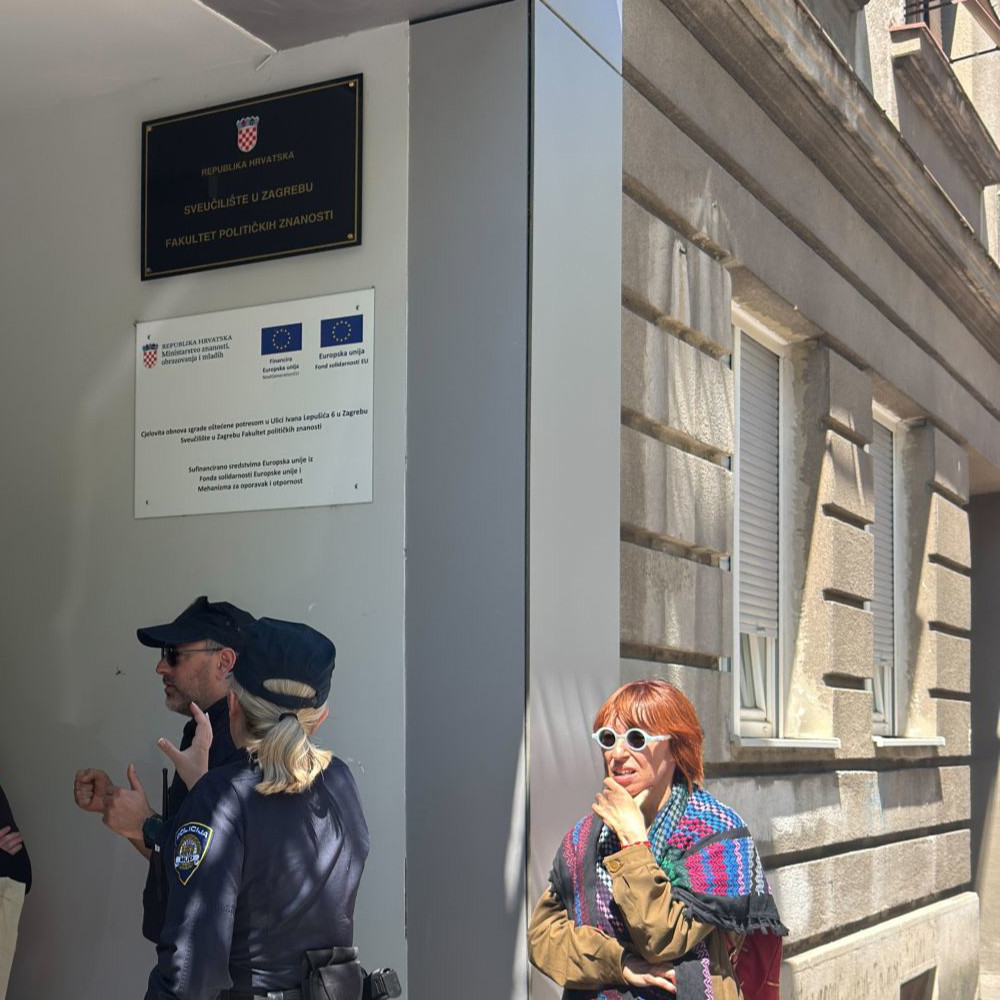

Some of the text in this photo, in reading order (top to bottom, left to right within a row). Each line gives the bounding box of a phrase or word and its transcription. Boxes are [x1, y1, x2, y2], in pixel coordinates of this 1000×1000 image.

[201, 151, 294, 176] REPUBLIKA HRVATSKA
[184, 181, 314, 215] SVEUČILIŠTE U ZAGREBU
[165, 210, 334, 249] FAKULTET POLITIČKIH ZNANOSTI
[162, 335, 232, 349] REPUBLIKA HRVATSKA
[161, 355, 197, 365] obrazovanja
[202, 352, 224, 361] mladih
[162, 347, 200, 358] Ministarstvo
[319, 347, 365, 360] Europska unija
[269, 356, 292, 364] Financira
[329, 359, 360, 368] solidarnosti
[262, 363, 299, 373] Europska unija
[141, 429, 165, 438] Cjelovita
[188, 425, 207, 434] zgrade
[208, 422, 234, 431] oštećene
[235, 420, 264, 429] potresom
[270, 416, 284, 424] Ulici
[303, 411, 330, 420] Lepušića
[342, 407, 368, 417] Zagrebu
[180, 434, 210, 443] Sveučilište
[217, 431, 241, 440] Zagrebu
[241, 428, 266, 437] Fakultet
[267, 425, 295, 436] političkih
[296, 423, 322, 432] znanosti
[188, 464, 228, 473] Sufinancirano
[229, 461, 261, 470] sredstvima
[291, 456, 307, 465] unije
[218, 472, 253, 480] solidarnosti
[254, 470, 281, 478] Europske
[282, 468, 298, 476] unije
[197, 484, 231, 492] Mehanizma
[240, 480, 268, 490] oporavak
[273, 478, 303, 487] otpornost
[176, 825, 209, 840] POLICIJA
